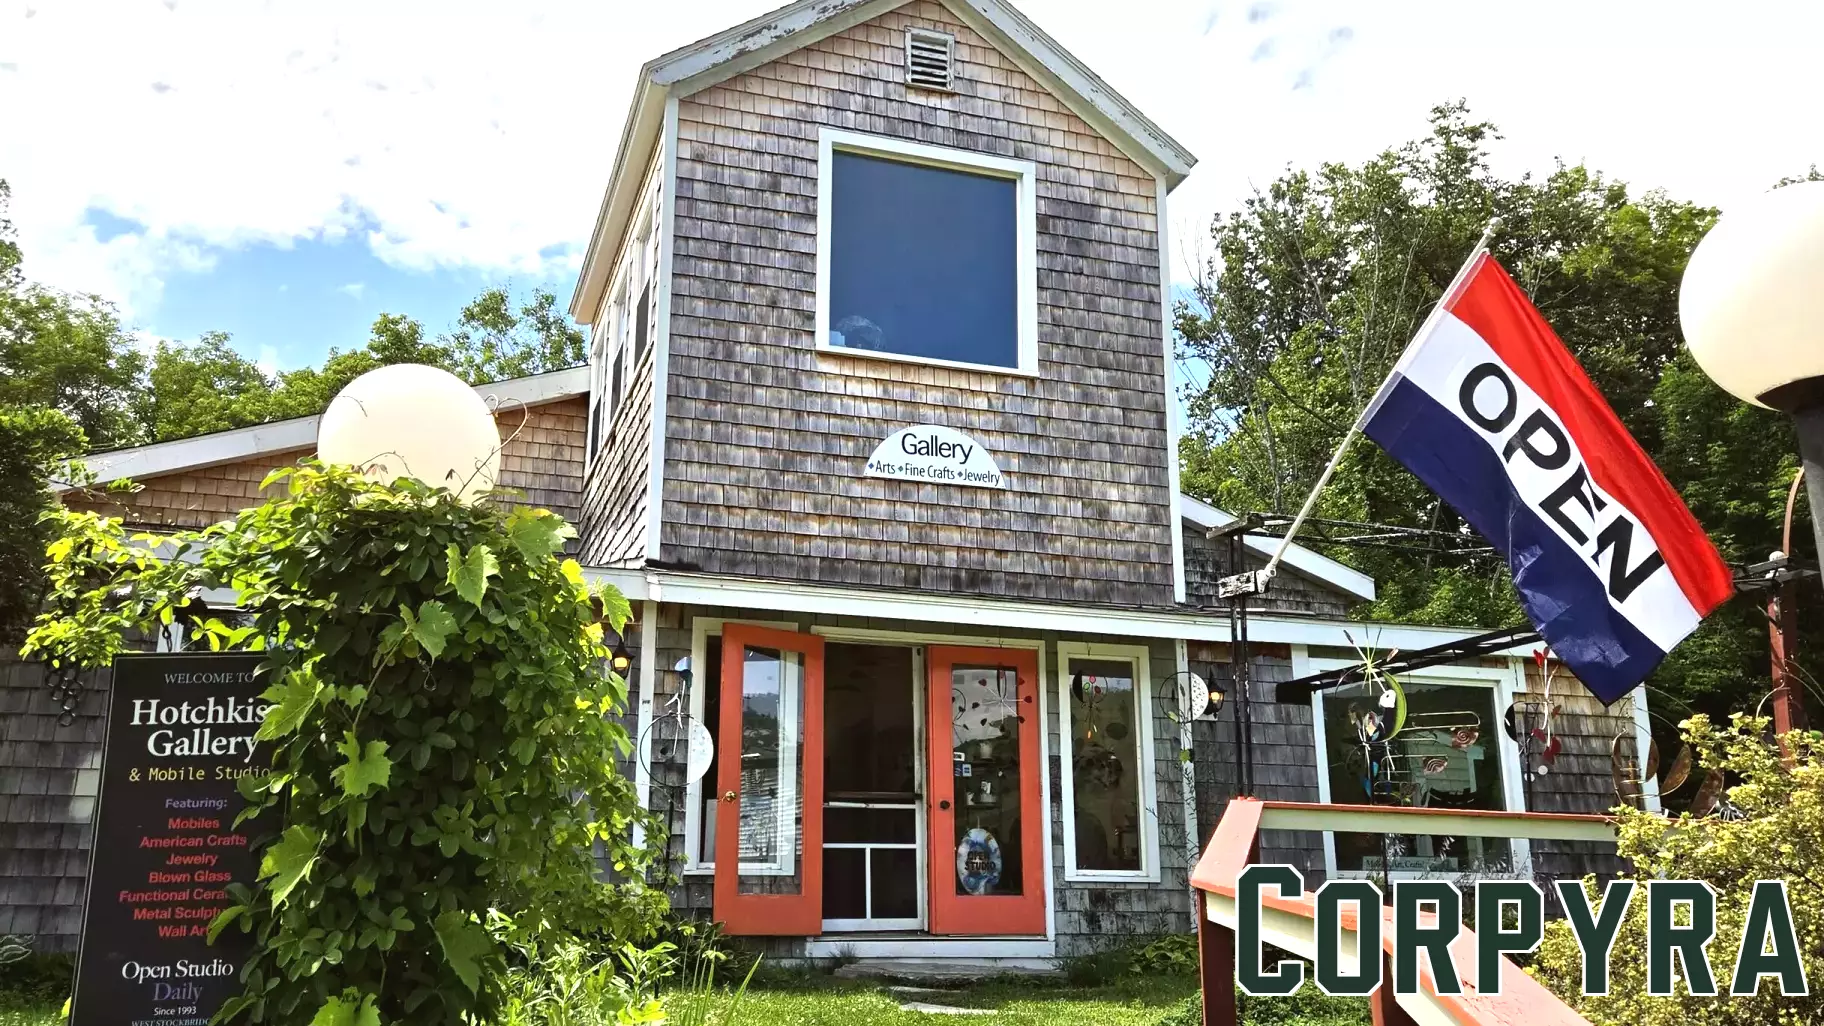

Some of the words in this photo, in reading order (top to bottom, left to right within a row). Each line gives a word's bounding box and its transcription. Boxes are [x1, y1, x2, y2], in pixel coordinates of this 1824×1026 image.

[901, 433, 973, 465] Gallery
[875, 460, 896, 475] Arts
[904, 462, 925, 478] Fine
[927, 465, 956, 480] Crafts
[963, 468, 1001, 487] Jewelry
[1459, 362, 1665, 604] OPEN
[164, 672, 234, 684] WELCOME
[236, 672, 255, 683] TO
[130, 696, 268, 725] Hotchkis
[147, 727, 259, 764] Gallery
[129, 767, 142, 782] &
[148, 766, 205, 781] Mobile
[215, 765, 271, 780] Studio
[165, 797, 228, 811] Featuring:
[168, 817, 220, 830] Mobiles
[139, 836, 203, 849] American
[207, 834, 247, 847] Crafts
[166, 853, 218, 867] Jewelry
[148, 872, 191, 884] Blown
[194, 870, 232, 882] Glass
[119, 889, 190, 902] Functional
[193, 888, 228, 900] Cera
[133, 907, 172, 920] Metal
[174, 906, 220, 920] Sculpt
[158, 925, 187, 937] Wall
[122, 961, 171, 984] Open
[175, 959, 234, 978] Studio
[153, 982, 203, 1004] Daily
[153, 1007, 176, 1016] Since
[178, 1006, 197, 1015] 1993
